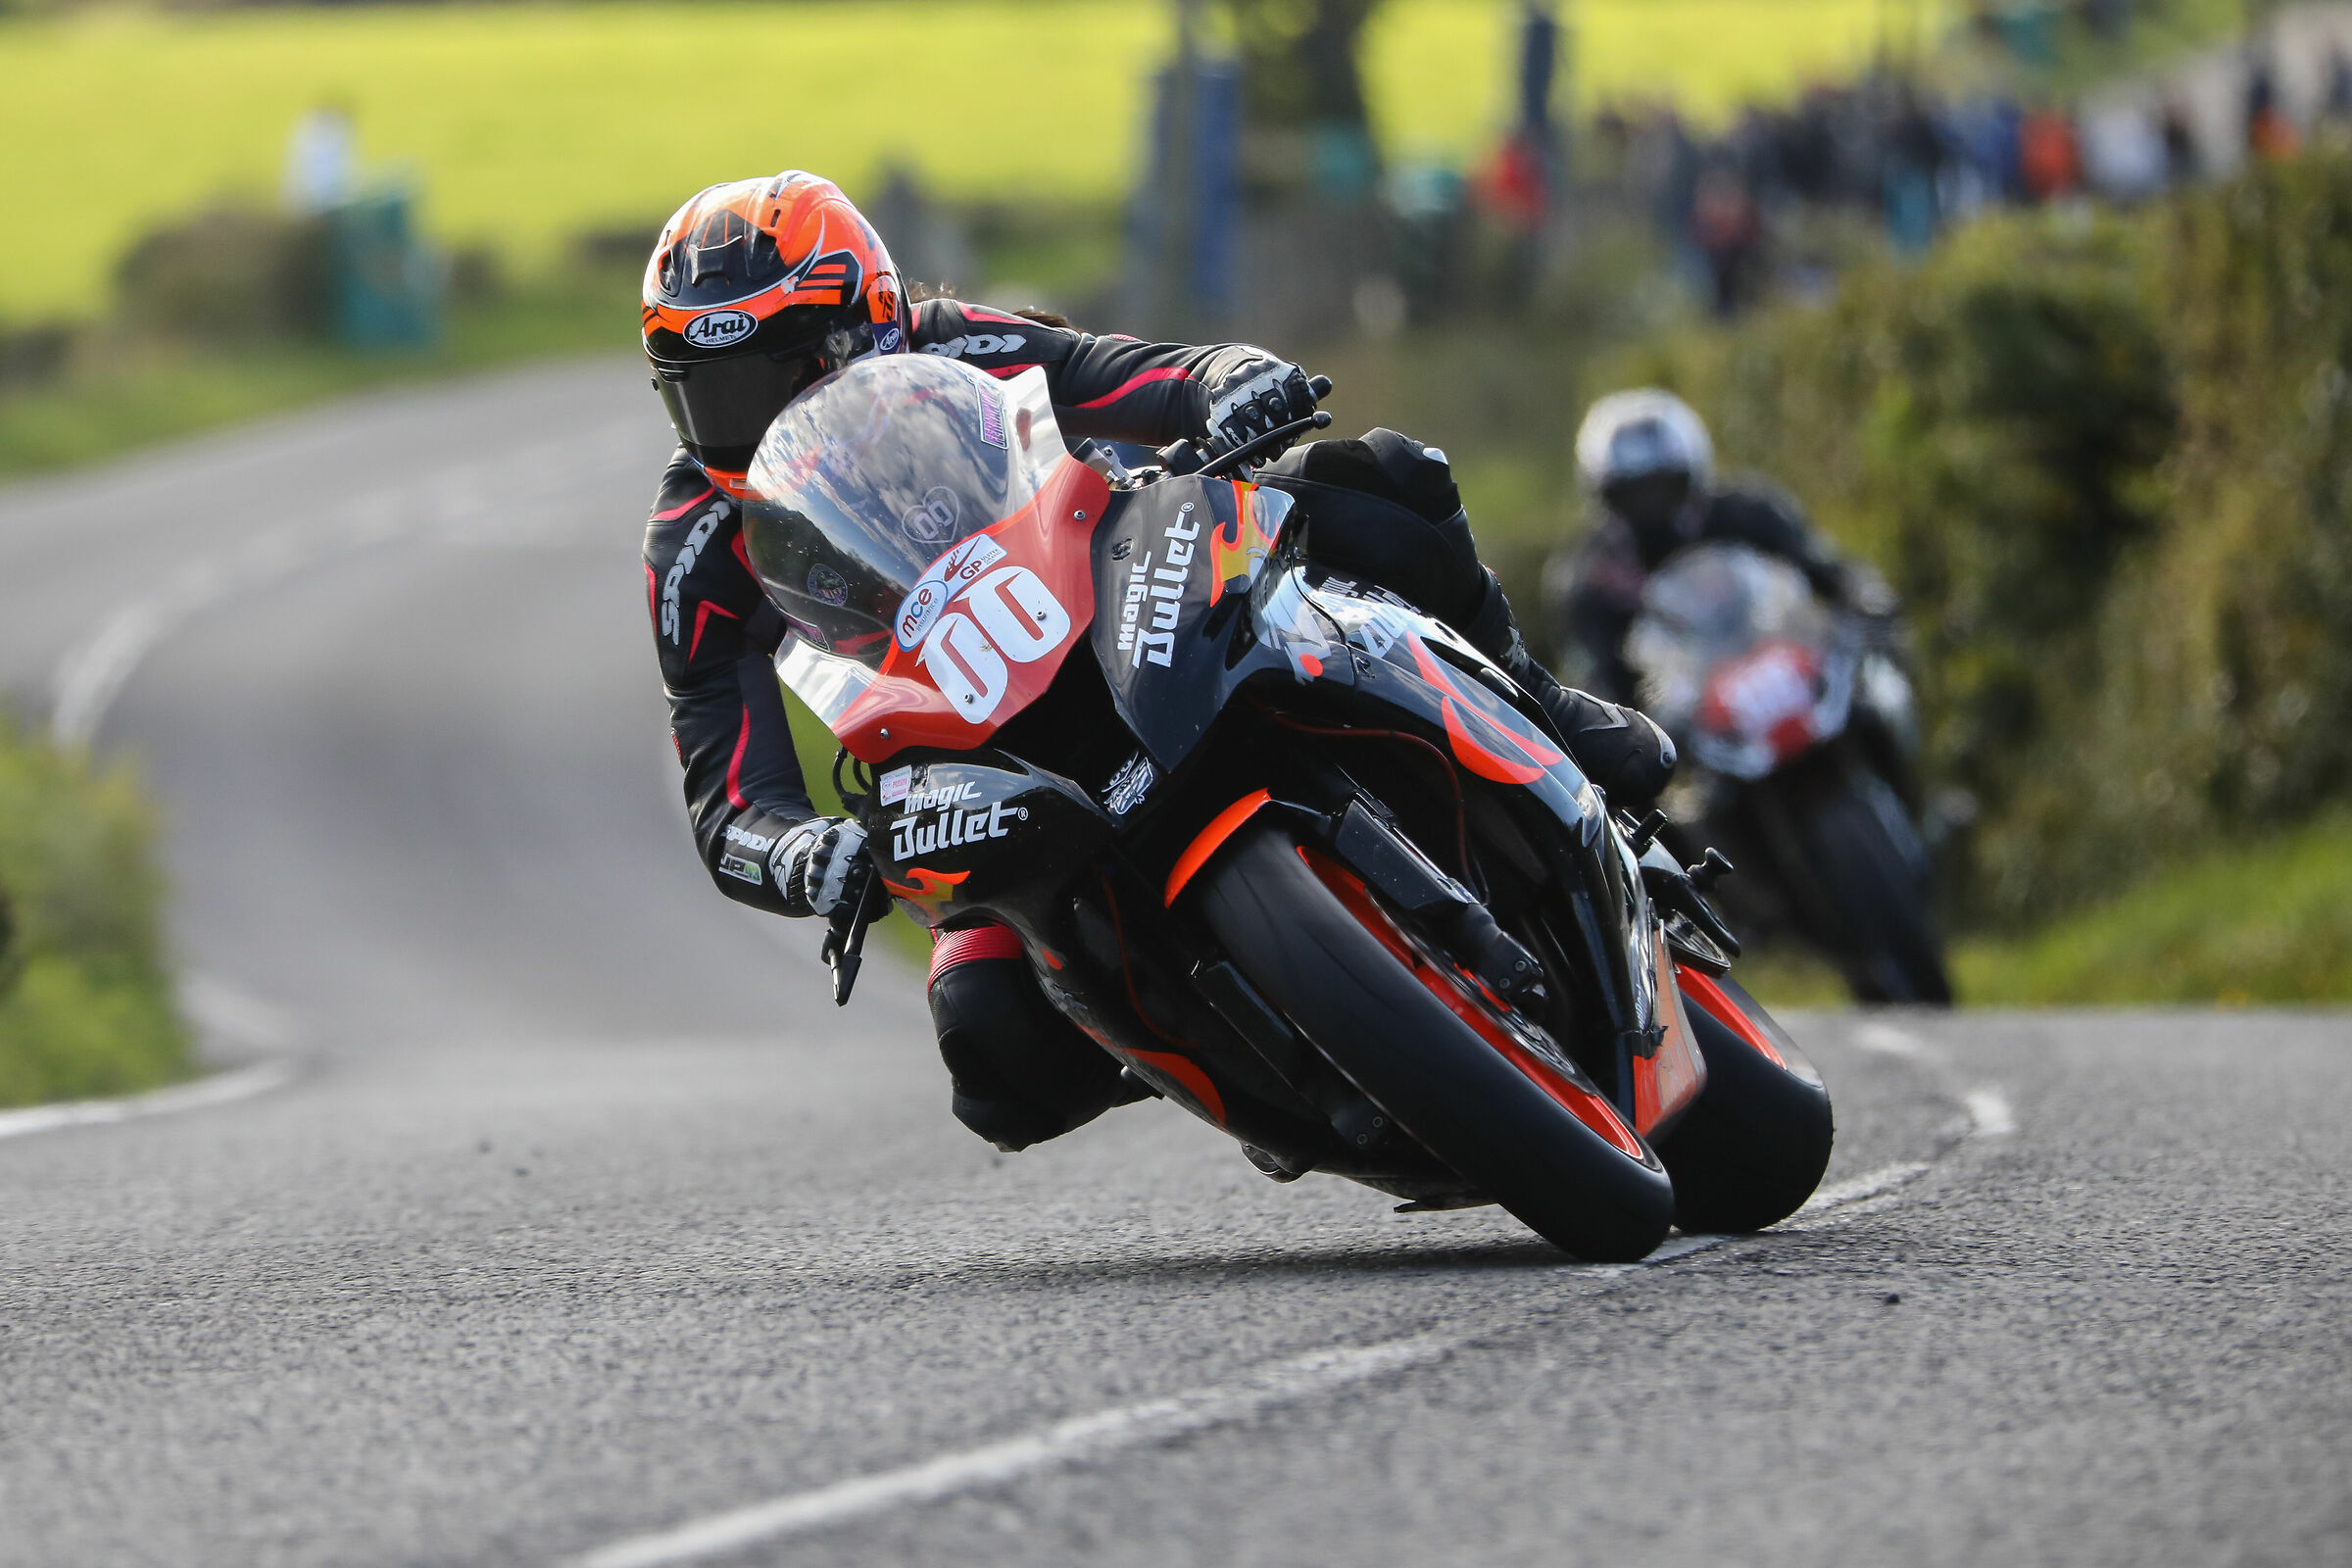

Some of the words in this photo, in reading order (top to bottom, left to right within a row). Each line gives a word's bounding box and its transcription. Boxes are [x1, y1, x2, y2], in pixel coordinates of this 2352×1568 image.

[689, 314, 747, 339] Arai
[919, 334, 1027, 359] PIDI
[661, 500, 731, 646] SPIDI
[959, 560, 983, 580] GP
[902, 588, 932, 638] mce
[915, 598, 939, 632] insurance
